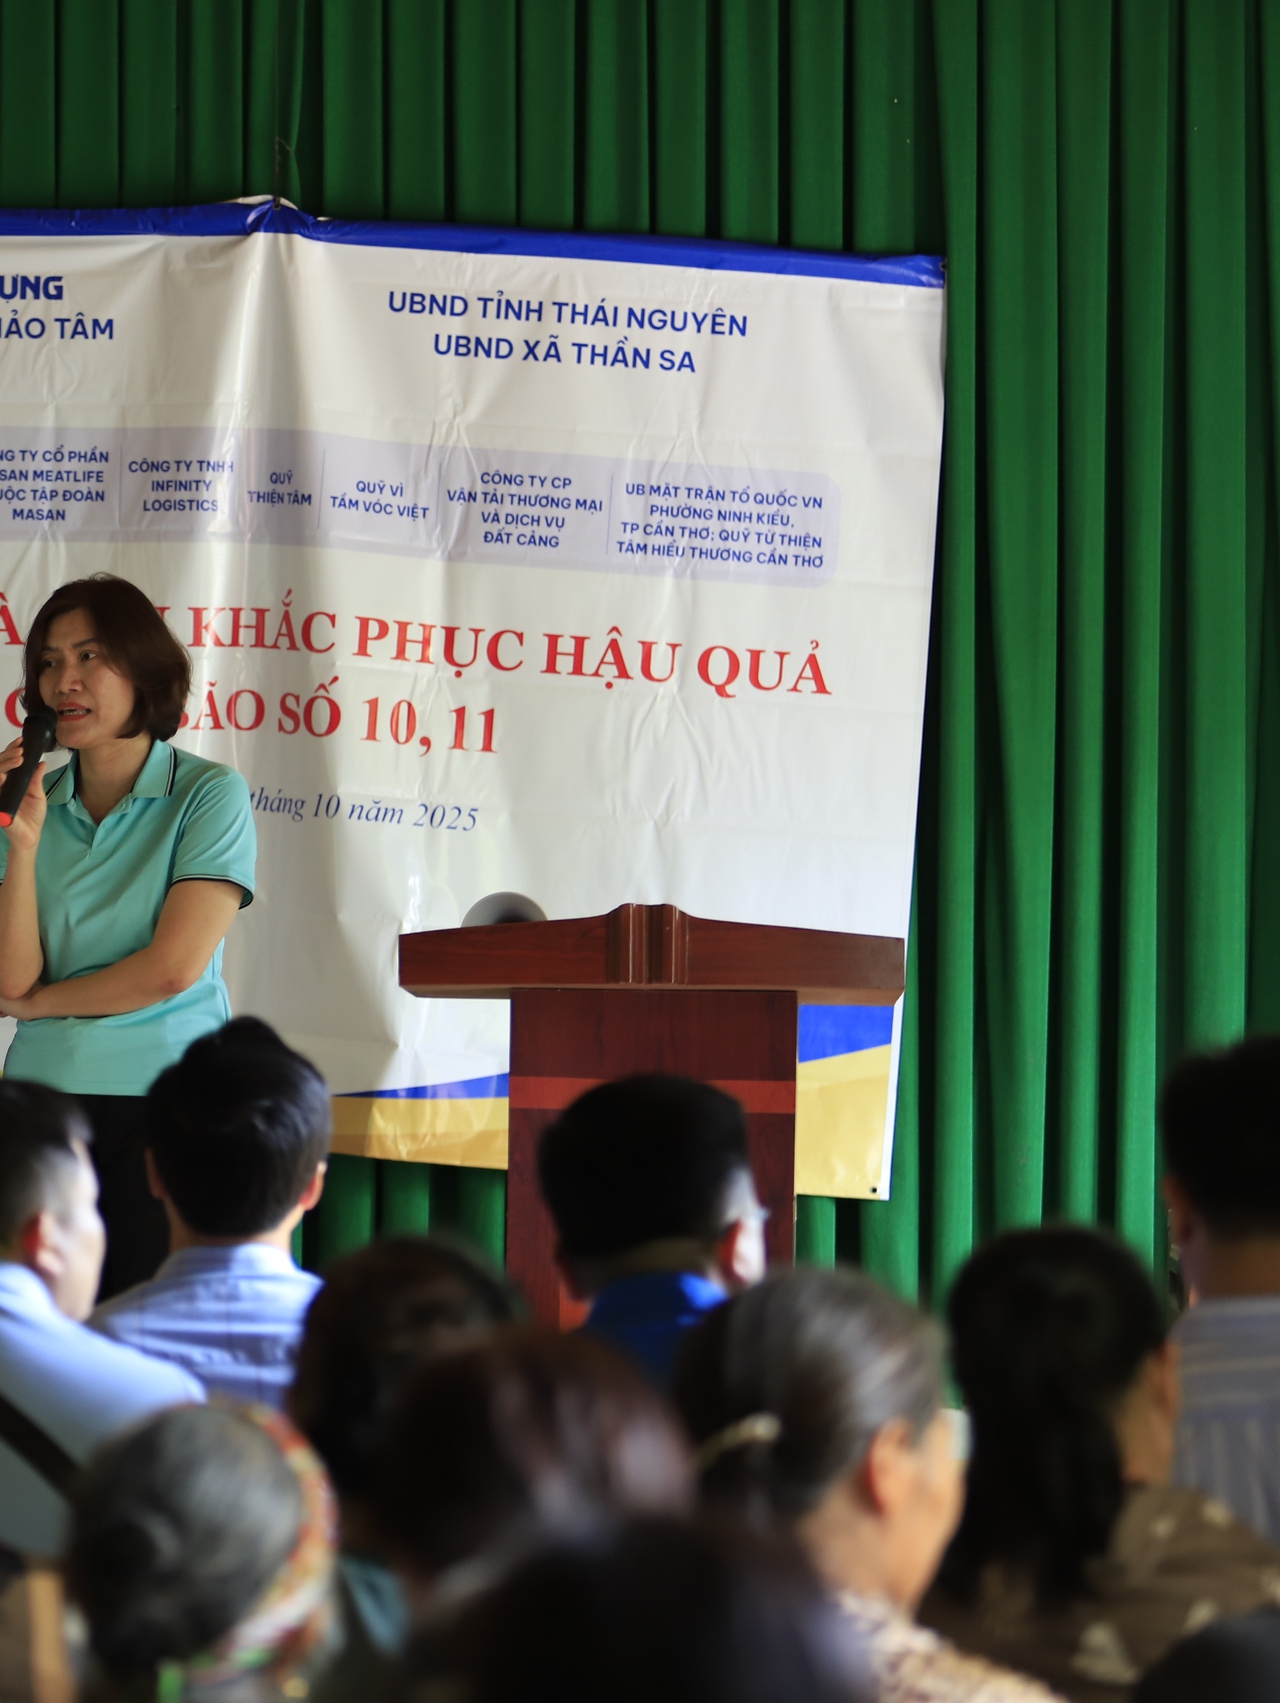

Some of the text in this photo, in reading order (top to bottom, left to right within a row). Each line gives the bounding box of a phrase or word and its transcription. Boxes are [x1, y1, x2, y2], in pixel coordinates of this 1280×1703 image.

[388, 290, 748, 337] UBND TỈNH THÁI NGUYÊN
[54, 312, 114, 340] TÂM
[433, 334, 696, 373] UBND XÃ THẦN SA
[18, 450, 39, 462] TY
[42, 444, 65, 462] CỔ
[68, 446, 109, 463] PHẦN
[128, 458, 234, 473] CÔNG TY TNHH
[32, 471, 104, 482] MEATLIFE
[151, 480, 212, 492] INFINITY
[269, 469, 293, 485] QUỸ
[480, 470, 572, 489] CÔNG TY CP
[30, 487, 58, 505] TẬP
[62, 487, 105, 502] ĐOÀN
[248, 488, 312, 507] THIỆN TÂM
[356, 479, 404, 498] QUỸ VÌ
[626, 482, 823, 509] UB MẶT TRẬN TỔ QUỐC VN
[143, 499, 218, 512] LOGISTICS
[330, 492, 429, 522] TẦM VÓC VIỆT
[447, 487, 603, 515] VẬN TẢI THƯƠNG MẠI
[12, 509, 66, 521] MASAN
[481, 508, 565, 532] VÀ DỊCH VỤ
[650, 504, 713, 521] PHƯỜNG
[717, 510, 752, 524] NINH
[483, 527, 559, 548] ĐẤT CẢNG
[621, 522, 639, 534] TP
[643, 519, 674, 537] CẦN
[719, 528, 750, 543] QUỸ
[755, 529, 776, 545] TỪ
[779, 533, 822, 552] THIỆN
[617, 539, 647, 554] TÂM
[689, 546, 753, 564] THƯƠNG
[756, 547, 788, 566] CẦN
[792, 554, 823, 568] THƠ
[187, 588, 336, 654] KHẮC
[352, 616, 524, 678] PHỤC
[540, 626, 683, 690] HẬU
[697, 640, 832, 699] QUẢ
[177, 680, 266, 731] ÃO
[278, 675, 341, 738] SỐ
[448, 705, 498, 753] 11
[249, 787, 479, 832] tháng 10 năm 2025
